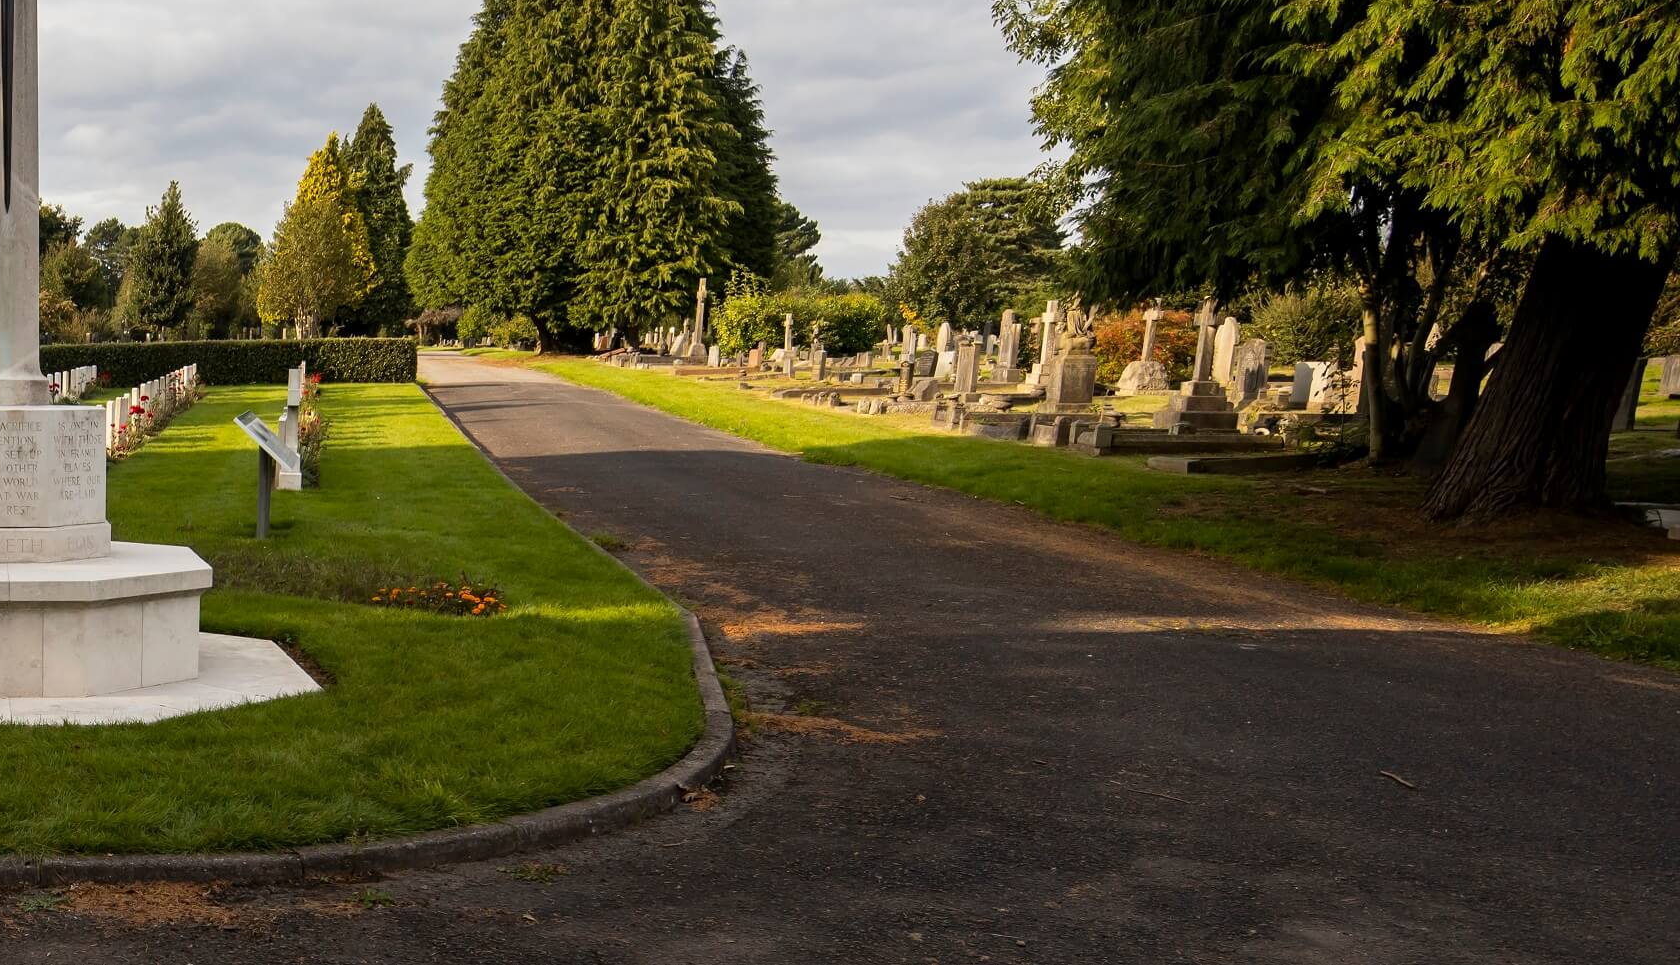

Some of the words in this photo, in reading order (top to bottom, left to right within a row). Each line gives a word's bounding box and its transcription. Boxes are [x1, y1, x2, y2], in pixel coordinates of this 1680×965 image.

[58, 421, 66, 430] IS
[90, 420, 99, 429] IN
[53, 435, 74, 445] WITH
[78, 434, 103, 445] THOSE
[5, 450, 24, 460] SET
[29, 450, 42, 460] UP
[58, 449, 66, 458] IN
[6, 463, 38, 473] OTHER
[64, 462, 92, 473] PLACES
[3, 477, 39, 487] WORLD
[53, 476, 81, 486] WHERE
[86, 476, 102, 485] OUR
[16, 491, 40, 501] WAR
[6, 505, 33, 516] REST
